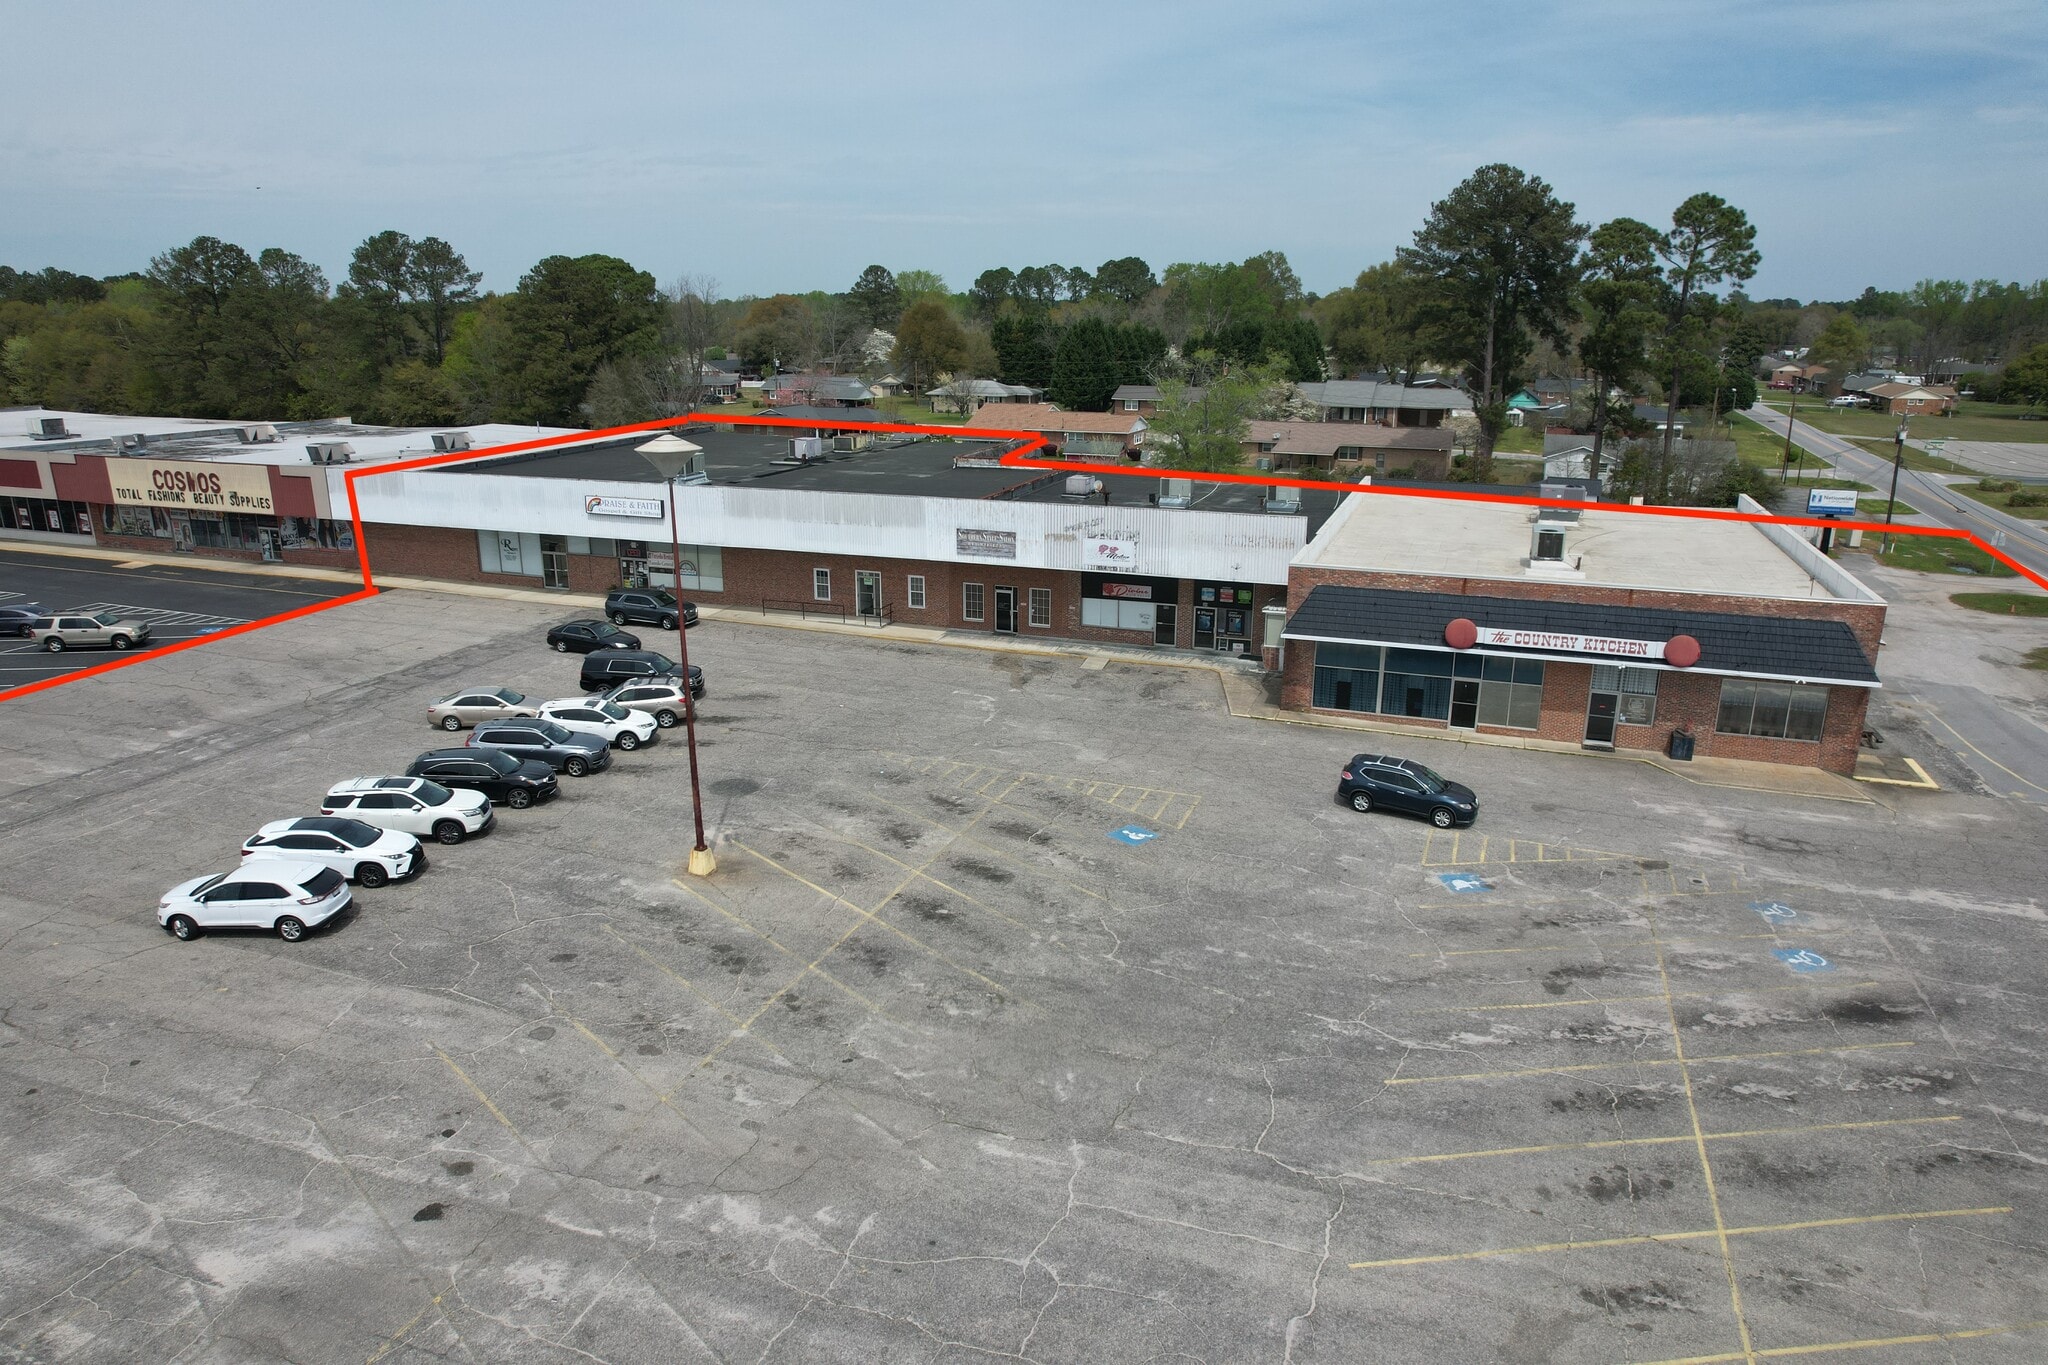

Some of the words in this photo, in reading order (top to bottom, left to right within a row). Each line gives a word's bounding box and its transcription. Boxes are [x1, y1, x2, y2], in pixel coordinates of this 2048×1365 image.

[116, 488, 142, 500] TOTAL
[147, 489, 186, 503] FASHIONS
[193, 492, 224, 506] BEAUTY
[229, 494, 271, 509] SUPPLIES
[599, 500, 627, 508] PRAISE
[637, 502, 660, 510] FAITH
[1113, 585, 1149, 596] Divine
[1514, 633, 1579, 649] COUNTRY
[1583, 638, 1648, 655] KITCHEN
